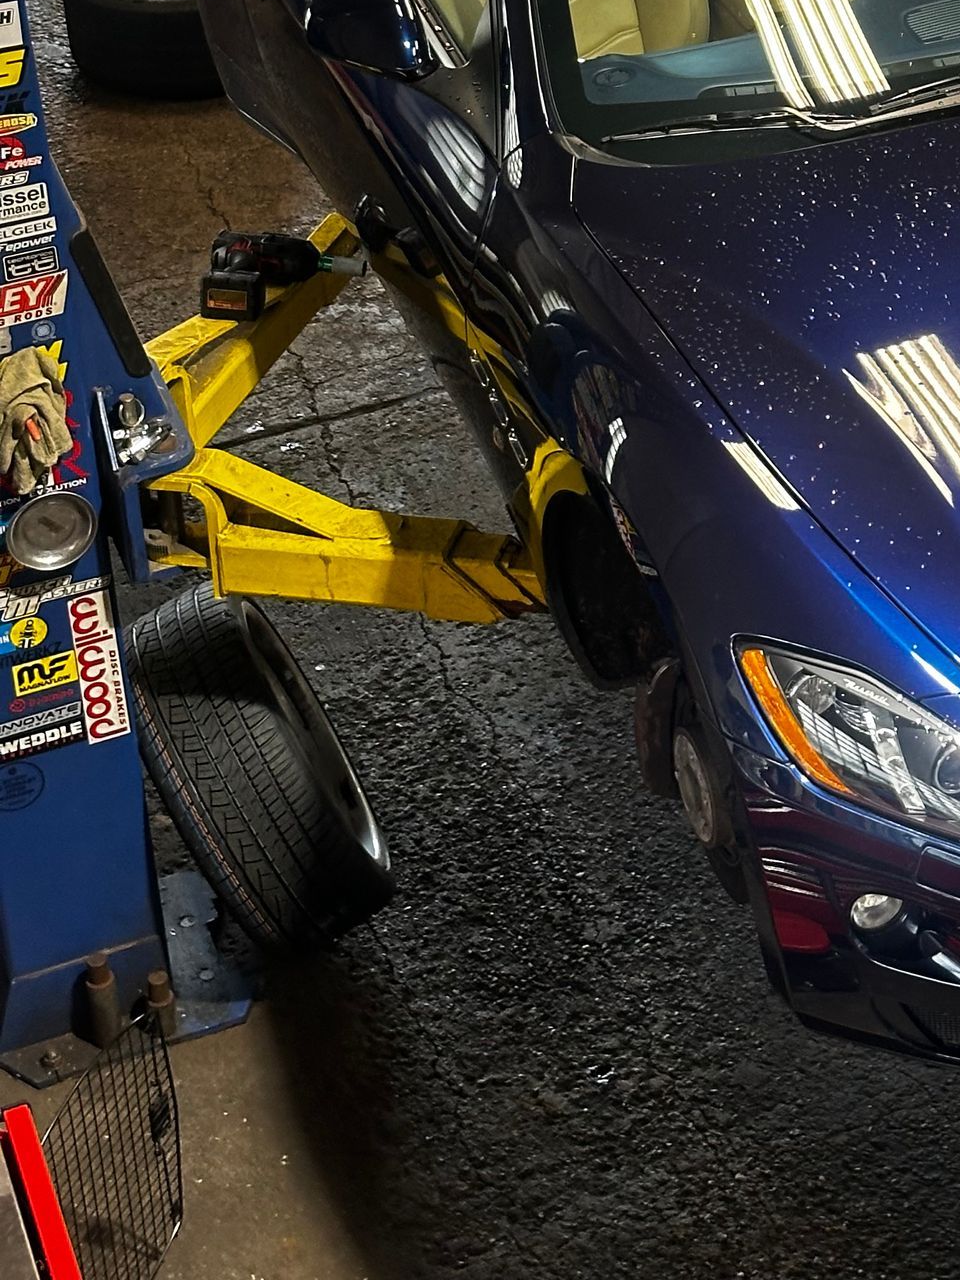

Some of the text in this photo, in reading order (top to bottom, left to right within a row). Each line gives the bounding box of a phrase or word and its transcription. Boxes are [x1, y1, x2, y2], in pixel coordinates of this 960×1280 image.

[0, 173, 27, 185] RS
[5, 156, 42, 171] POWER
[0, 281, 47, 314] EY
[14, 307, 53, 323] RODS
[4, 577, 111, 620] MASTERS
[19, 674, 71, 693] MAGNAFLOW
[70, 596, 128, 740] wilwood
[108, 650, 127, 725] DISC BRAKES
[0, 721, 83, 755] WEDDLE
